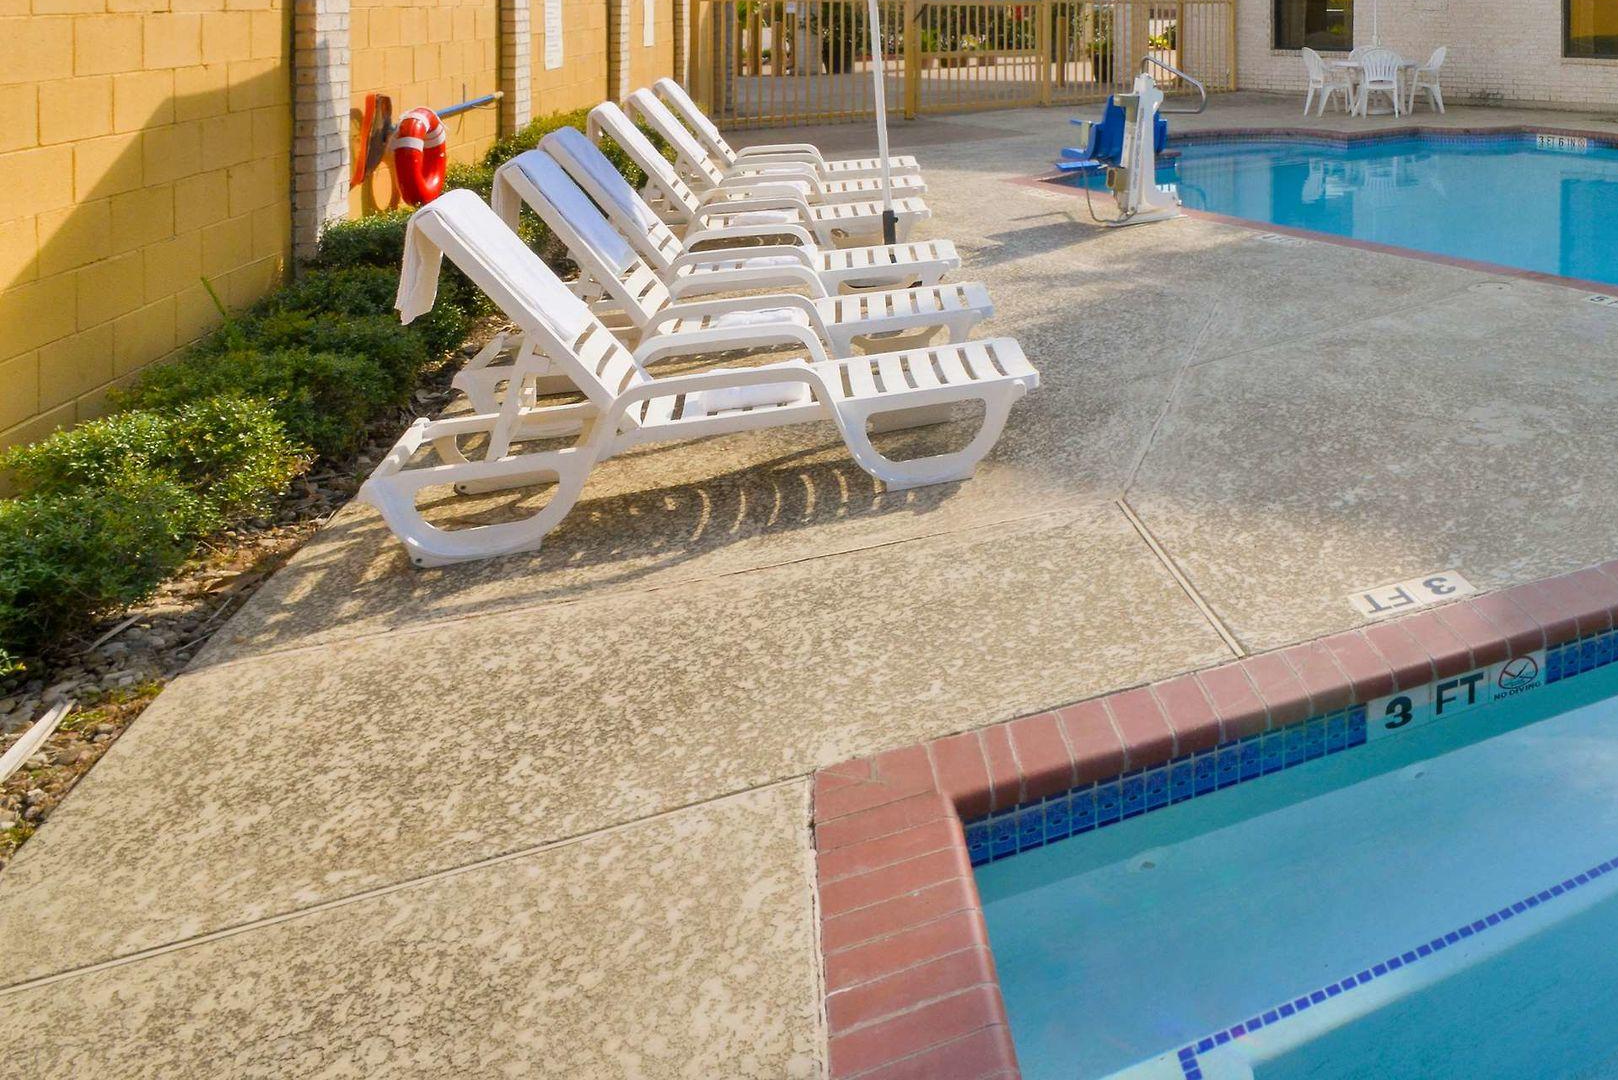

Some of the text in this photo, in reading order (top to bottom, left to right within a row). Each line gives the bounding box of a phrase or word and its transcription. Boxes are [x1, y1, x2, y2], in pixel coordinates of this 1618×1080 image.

[1363, 576, 1456, 614] 3 FT
[1384, 672, 1484, 730] 3 FT
[1493, 681, 1541, 701] NO DIVING
